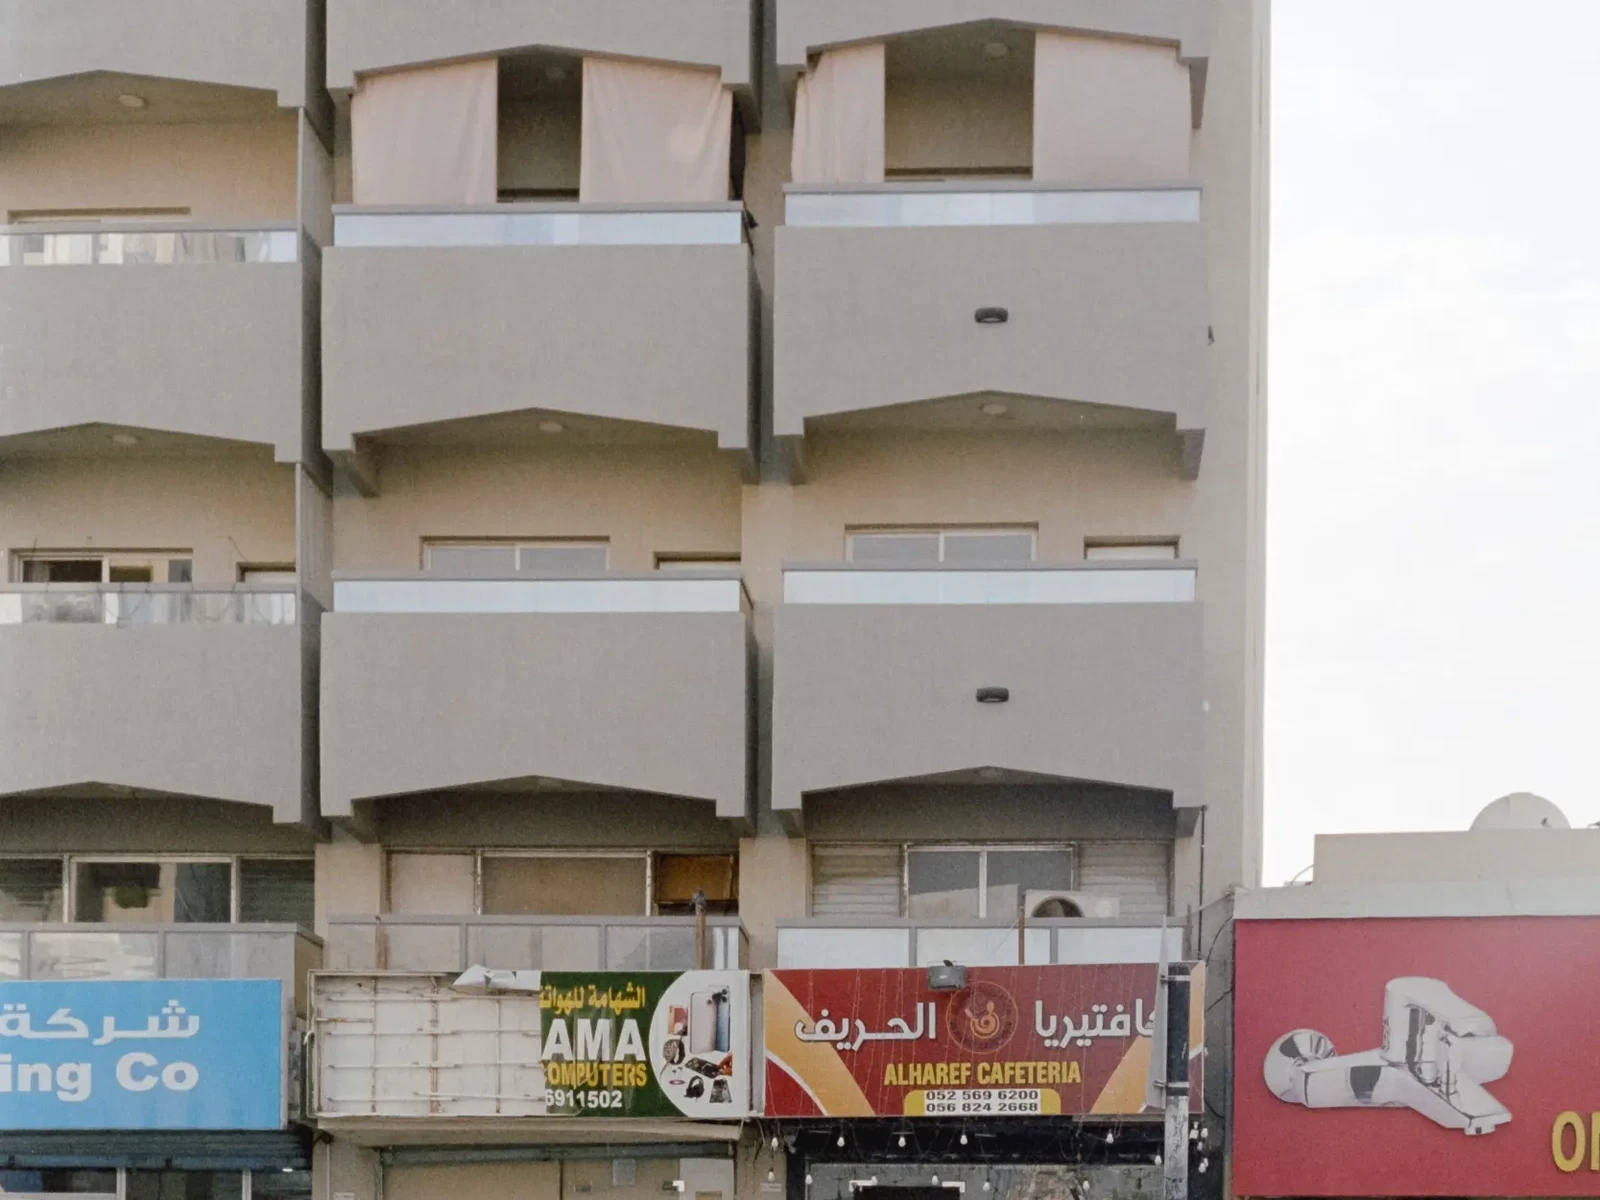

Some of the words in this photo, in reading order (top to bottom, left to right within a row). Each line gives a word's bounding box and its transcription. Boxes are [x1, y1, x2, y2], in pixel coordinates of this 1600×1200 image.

[0, 999, 200, 1046] شركة
[795, 1002, 936, 1051] الحريف
[0, 1053, 92, 1102] ing
[115, 1051, 199, 1092] Co
[541, 1062, 648, 1087] OMPUTERS
[883, 1063, 971, 1086] ALHAREF
[977, 1061, 1082, 1085] CAFETERIA
[925, 1090, 957, 1101] 052
[962, 1090, 992, 1101] 569
[997, 1089, 1039, 1101] 6200
[925, 1103, 956, 1113] 056
[961, 1102, 992, 1113] 824
[997, 1102, 1039, 1113] 2668
